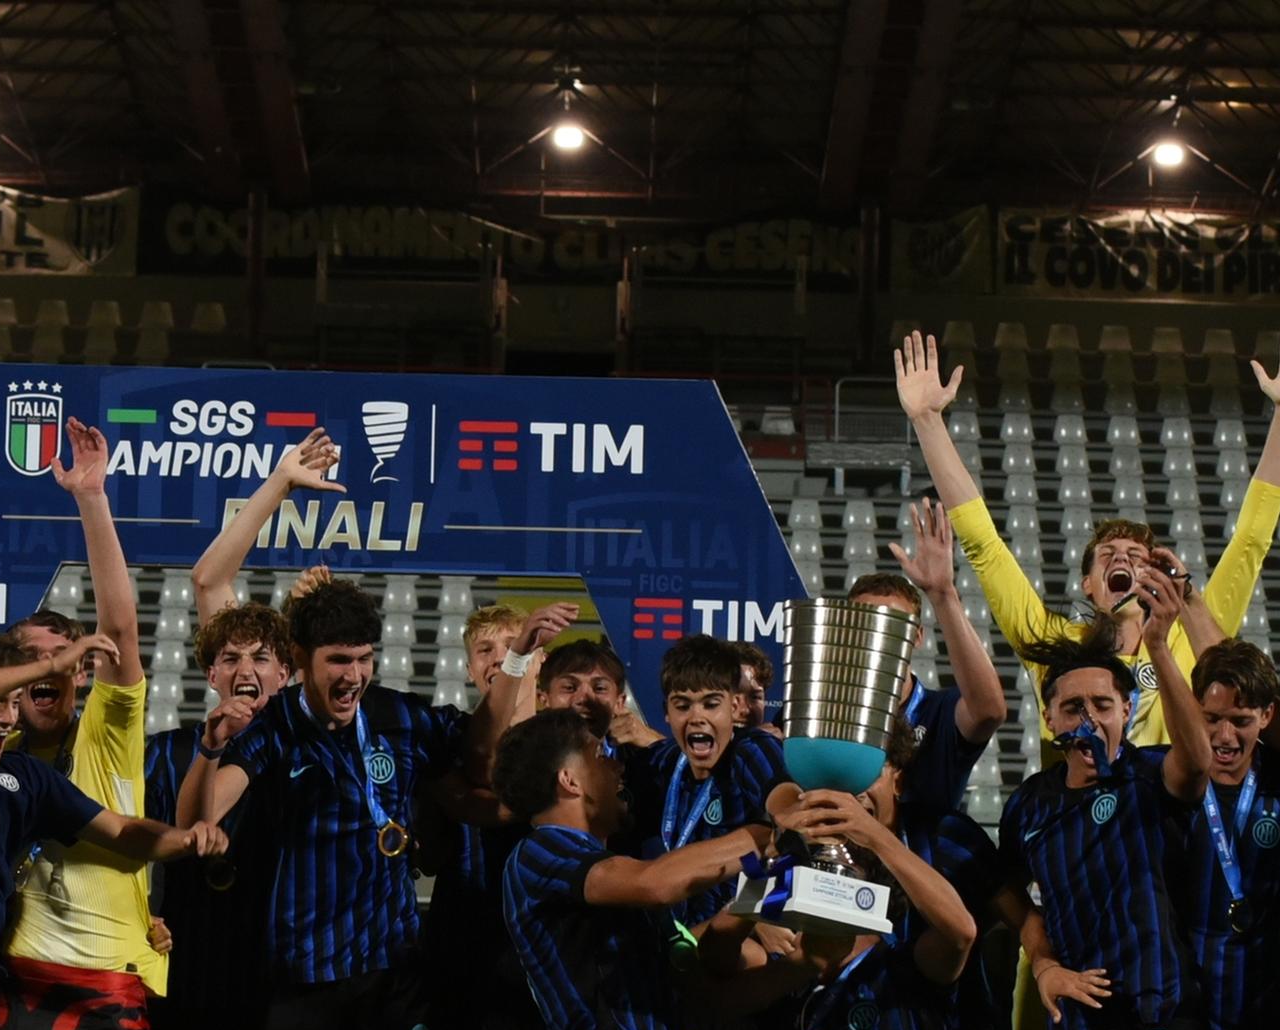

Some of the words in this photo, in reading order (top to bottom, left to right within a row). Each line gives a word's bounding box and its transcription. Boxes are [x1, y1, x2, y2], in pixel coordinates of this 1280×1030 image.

[165, 201, 545, 266] COORDINAMENO
[1045, 245, 1149, 291] COVO
[1158, 250, 1215, 293] DEI
[11, 400, 57, 417] ITALIA
[169, 399, 255, 437] SGS
[106, 440, 341, 480] AMPIONI
[530, 422, 644, 474] TIM
[583, 518, 740, 569] ITALIA
[638, 573, 684, 593] FIGC
[692, 599, 784, 643] TIM
